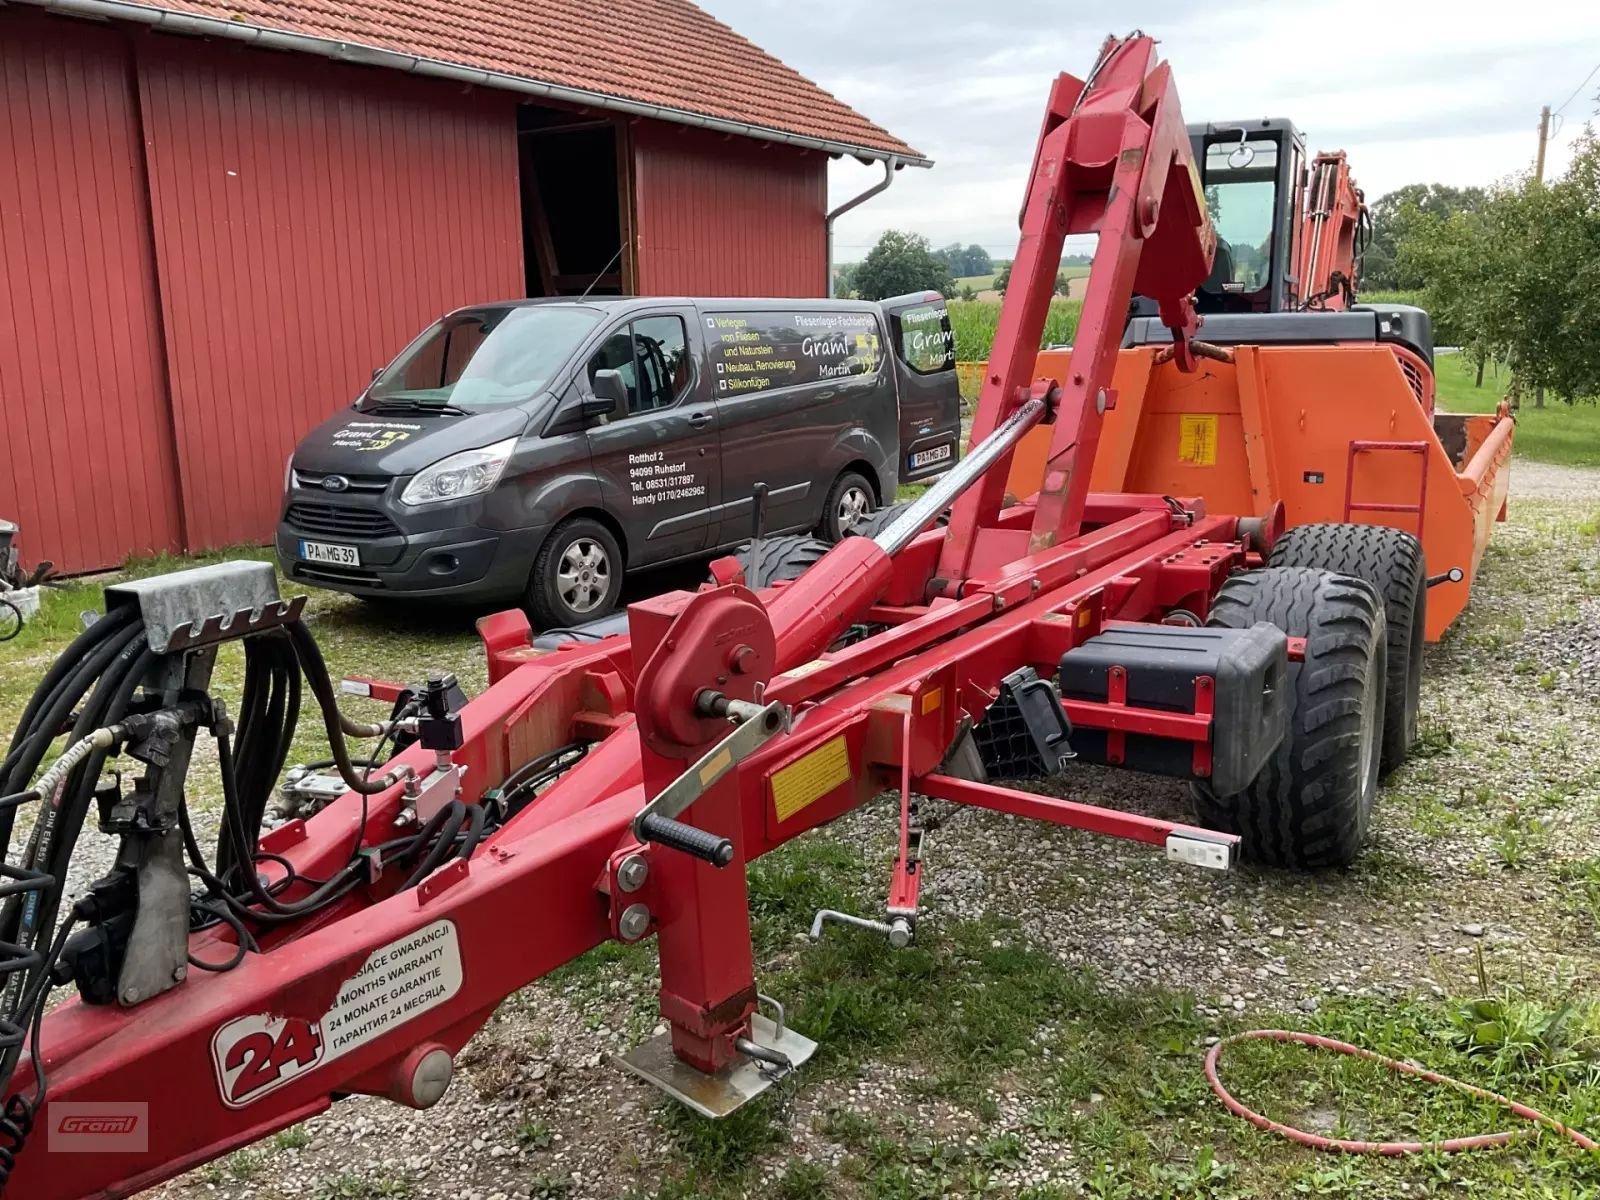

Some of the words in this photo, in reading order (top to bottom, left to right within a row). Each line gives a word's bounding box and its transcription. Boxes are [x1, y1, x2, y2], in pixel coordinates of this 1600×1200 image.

[714, 318, 747, 329] Verlegen
[721, 334, 735, 342] von
[735, 332, 760, 341] Fliesen
[724, 346, 738, 357] und
[738, 344, 773, 356] Naturstein
[802, 335, 849, 358] Graml
[755, 360, 796, 371] Renovierung
[819, 362, 851, 376] Martin
[658, 451, 664, 460] 2
[917, 453, 926, 464] PA
[930, 449, 939, 460] MG
[940, 446, 948, 457] 39
[630, 466, 653, 477] 94099
[654, 462, 686, 474] Ruhstorf
[631, 482, 644, 492] Tel.
[646, 474, 695, 490] 08531/317897
[632, 493, 656, 505] Handy
[307, 544, 321, 559] PA
[326, 547, 340, 561] MG
[341, 548, 354, 563] 39
[46, 811, 56, 828] DIN
[390, 925, 449, 960] GWARANCJI
[341, 976, 386, 1005] MONTHS
[388, 946, 444, 981] WARRANTY
[329, 1018, 342, 1031] 24
[344, 994, 388, 1023] MONATE
[390, 967, 442, 999] GARANTIE
[333, 1014, 388, 1049] ГАРАНТИЯ
[390, 1009, 402, 1020] 24
[404, 984, 446, 1012] МЕСЯЦА
[225, 1018, 322, 1101] 24
